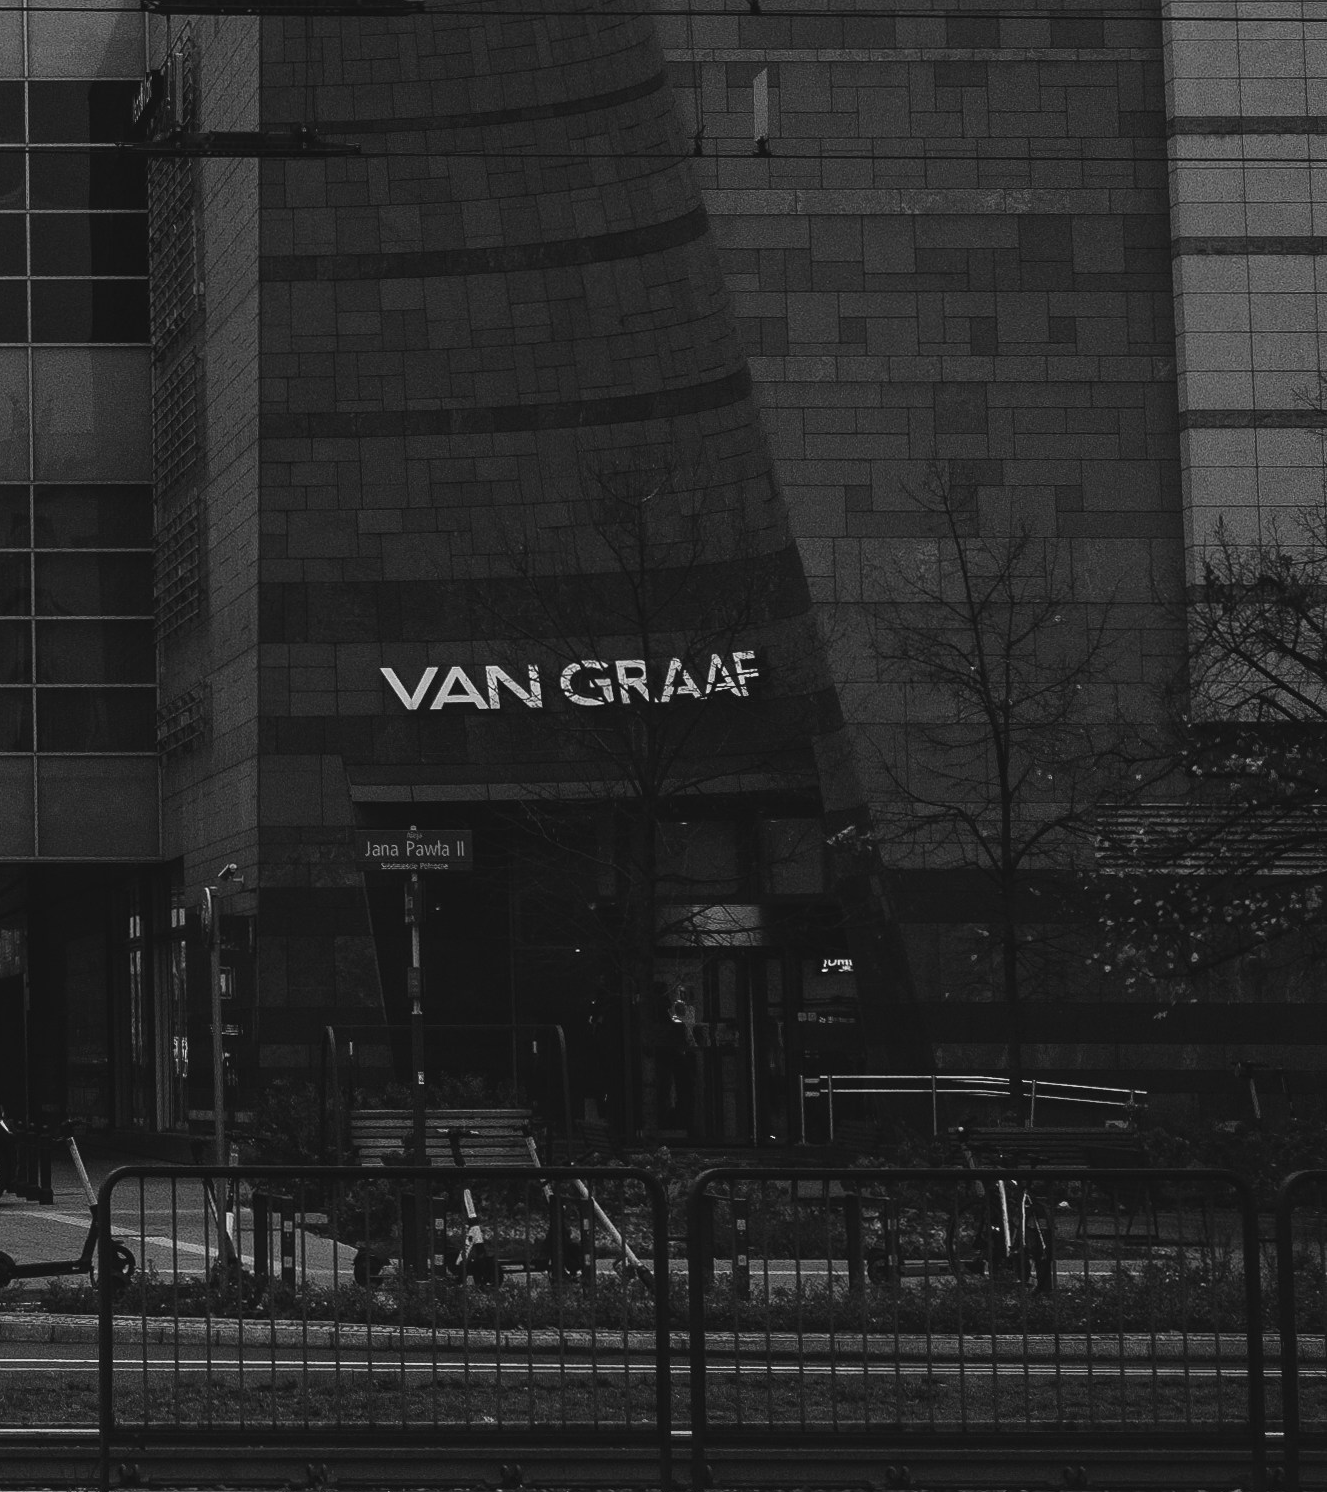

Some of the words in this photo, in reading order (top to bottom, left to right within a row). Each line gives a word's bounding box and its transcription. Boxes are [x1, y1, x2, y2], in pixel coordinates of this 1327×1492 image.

[379, 664, 543, 711] VAN
[559, 650, 760, 707] GRAAF
[365, 840, 399, 857] Jana
[406, 839, 450, 857] Pawła
[457, 840, 465, 857] II
